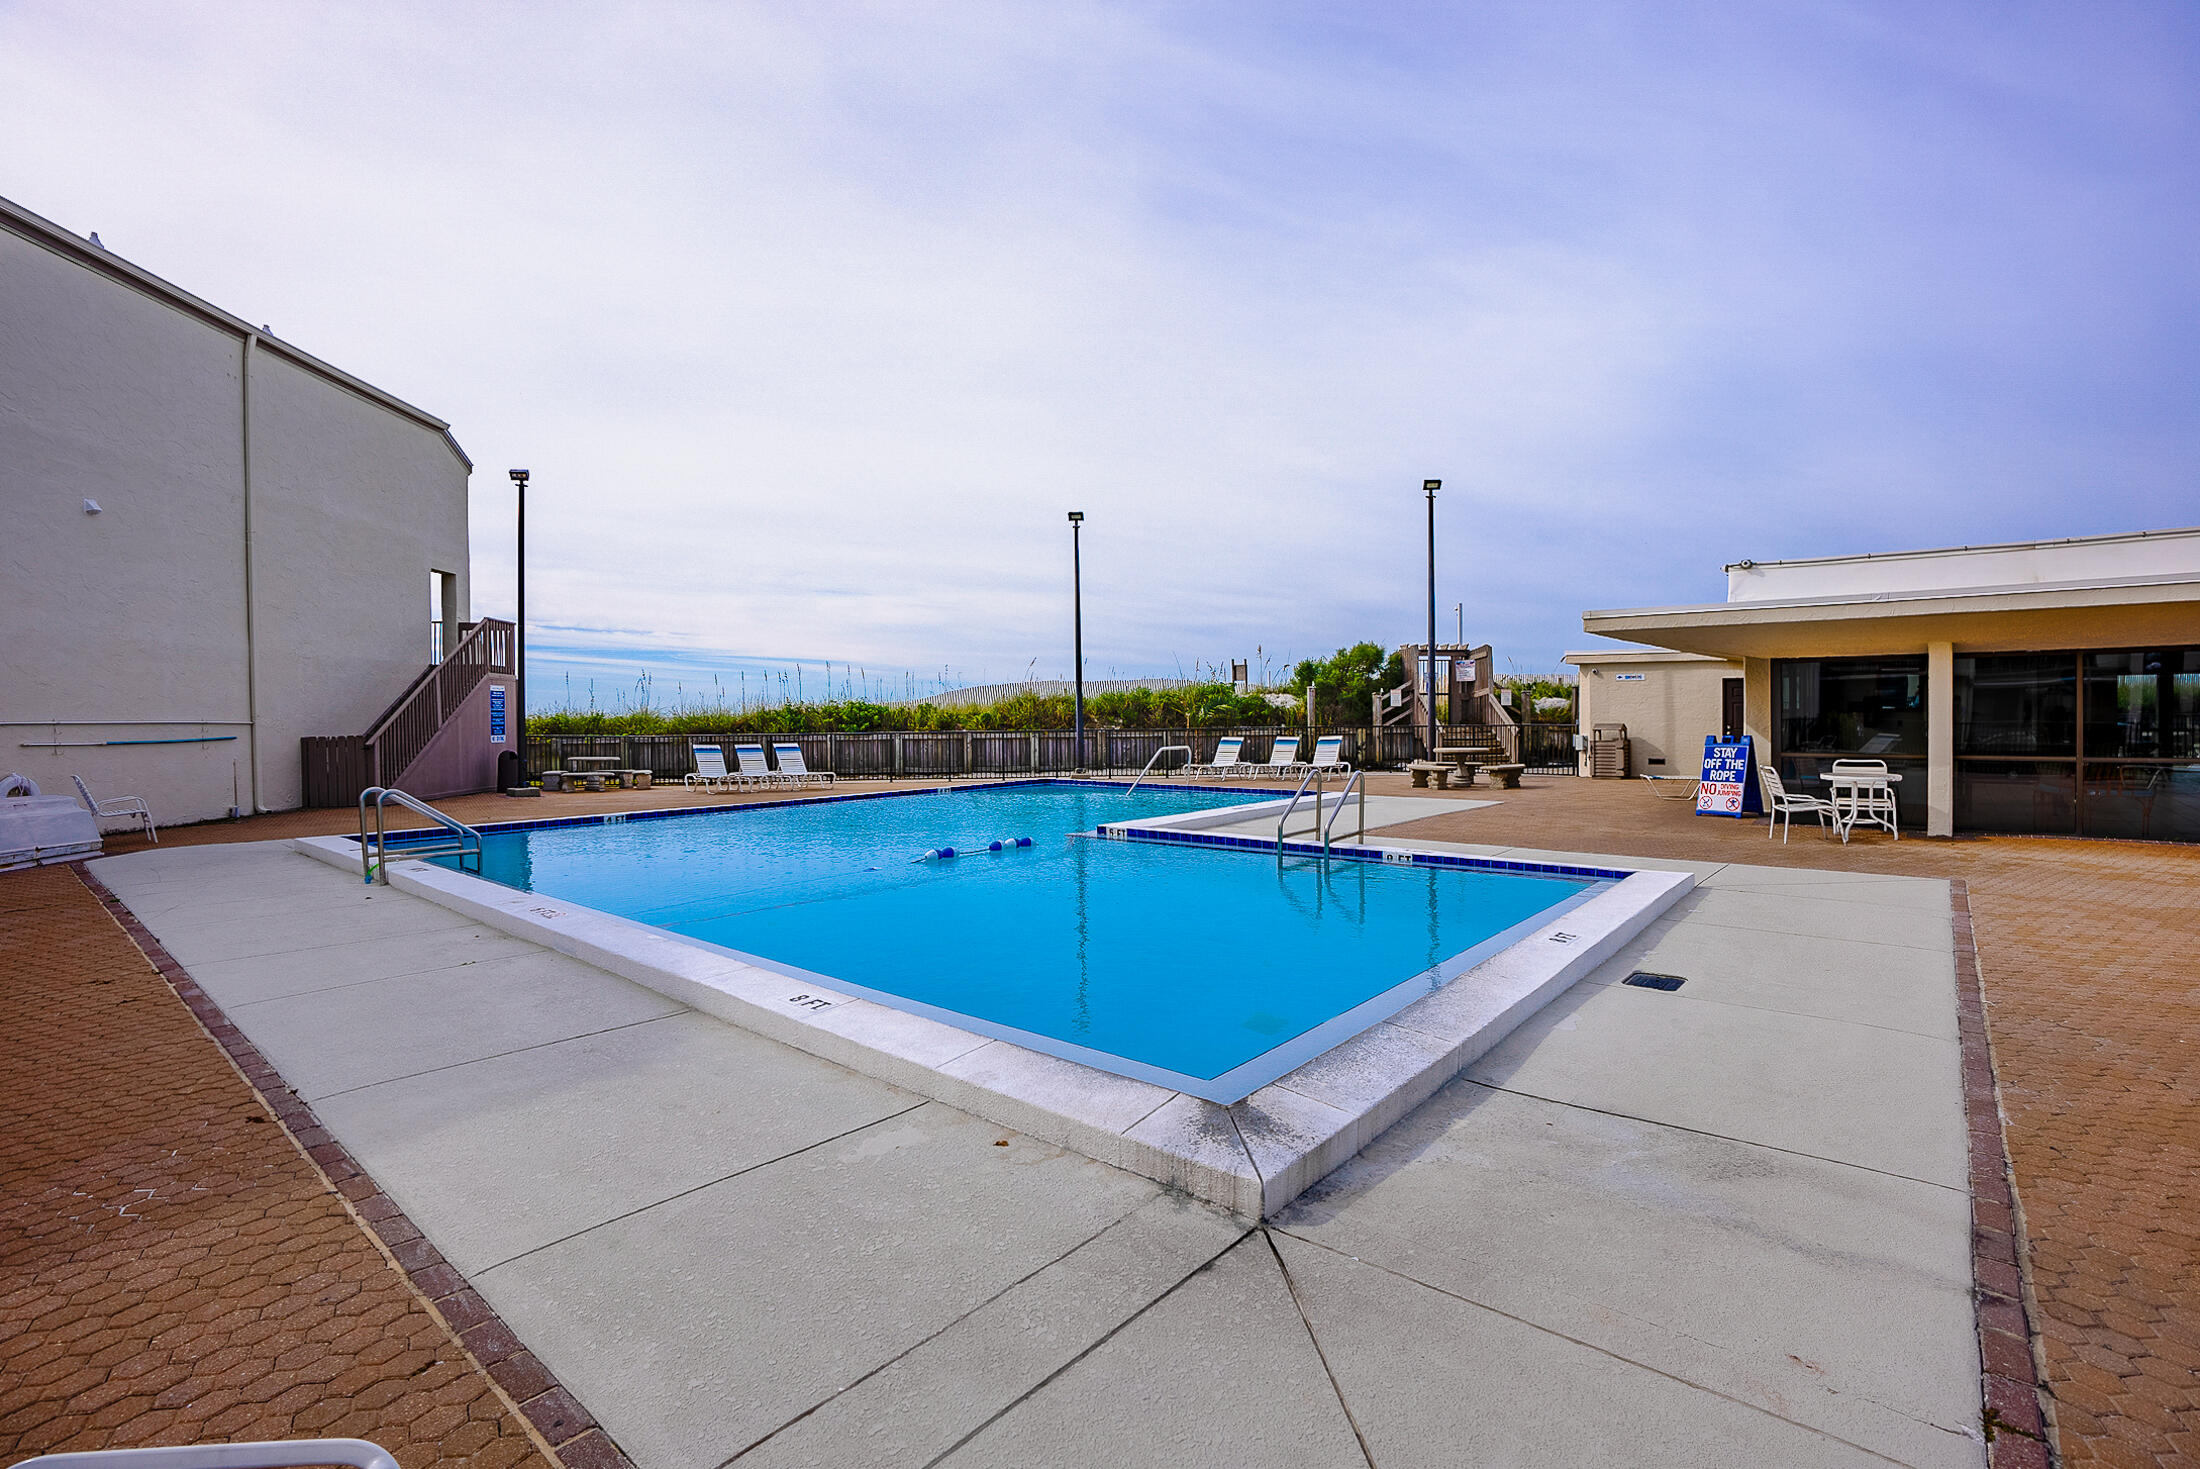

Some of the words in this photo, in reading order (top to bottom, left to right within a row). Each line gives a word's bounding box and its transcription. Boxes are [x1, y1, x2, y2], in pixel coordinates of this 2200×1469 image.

[1714, 747, 1738, 758] STAY
[1704, 758, 1722, 769] OFF
[1725, 759, 1744, 770] THE
[1710, 770, 1736, 781] ROPE
[1701, 783, 1717, 795] NO
[789, 994, 810, 1002] 8
[801, 999, 832, 1010] FT
